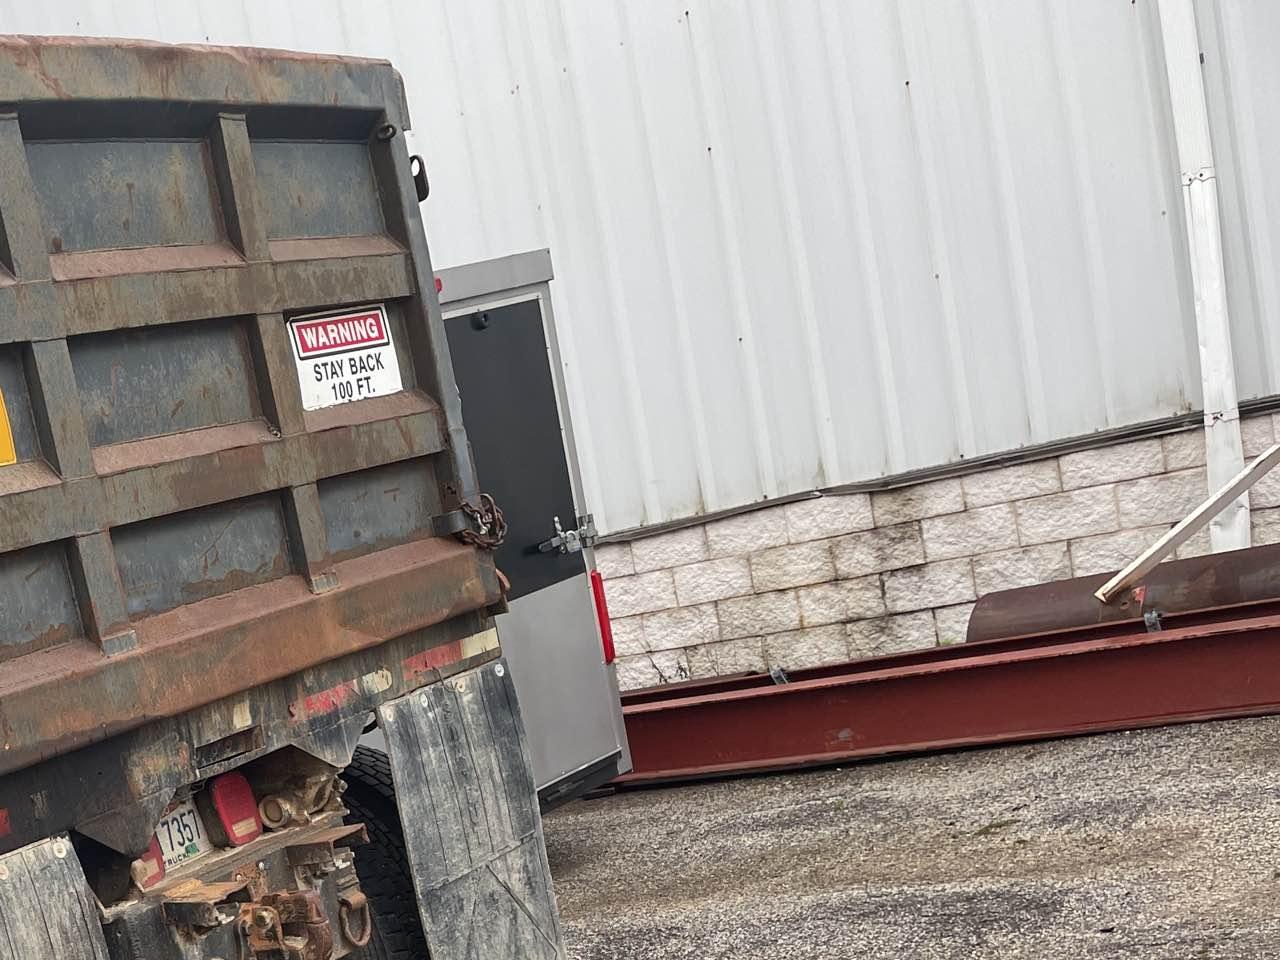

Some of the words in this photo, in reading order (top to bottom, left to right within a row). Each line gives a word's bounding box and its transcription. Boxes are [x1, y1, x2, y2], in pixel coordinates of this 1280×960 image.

[301, 318, 380, 349] WARNING
[313, 359, 344, 382] STAY
[348, 352, 384, 375] BACK
[331, 381, 353, 400] 100
[356, 376, 376, 395] FT.
[156, 809, 201, 856] 7357
